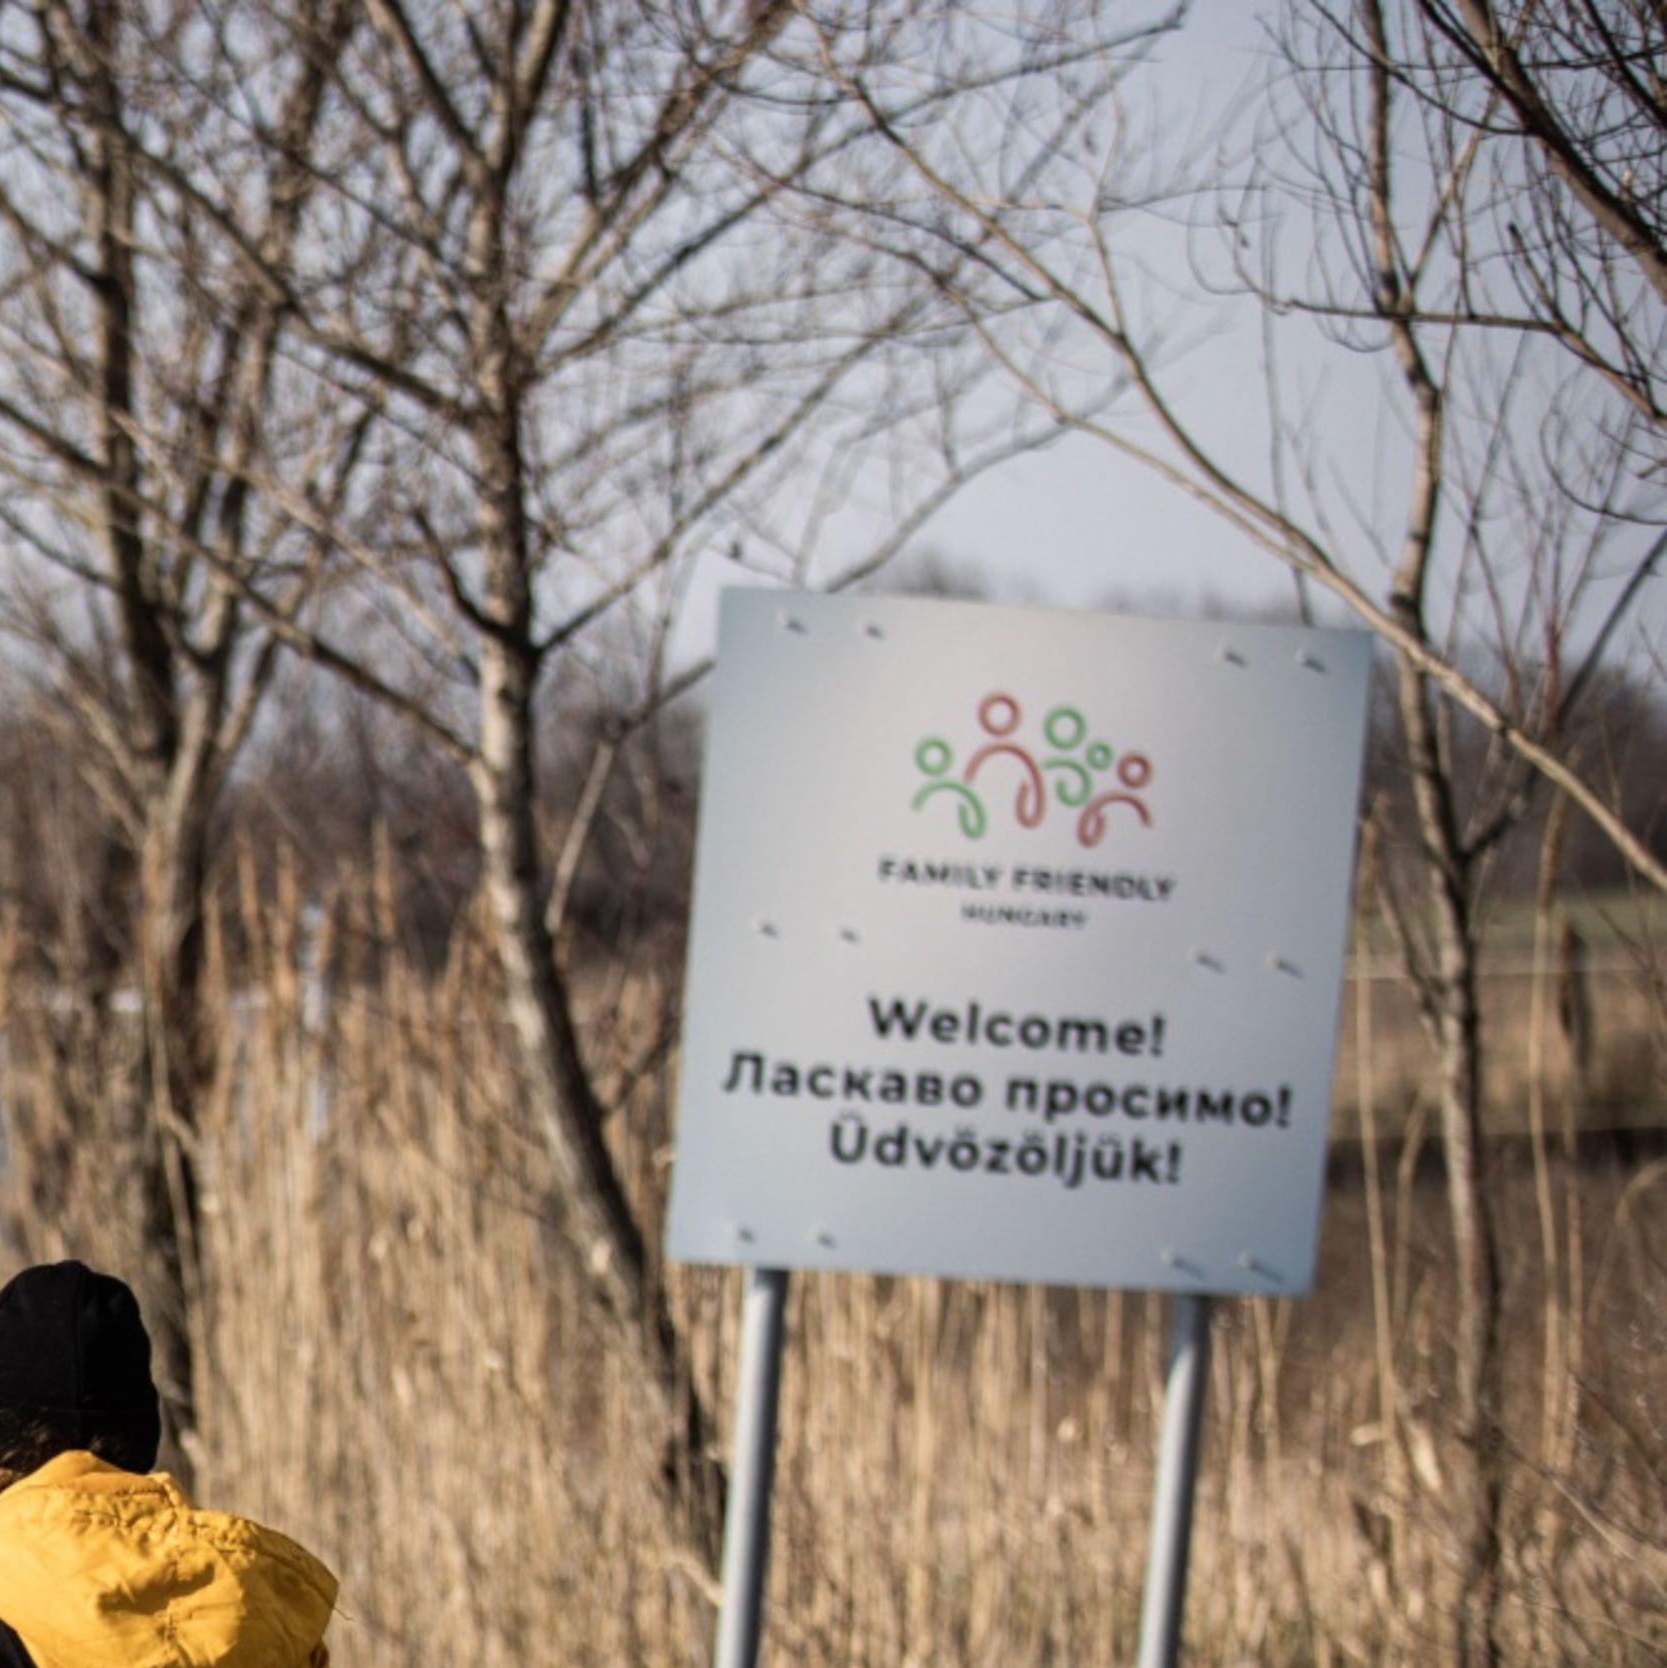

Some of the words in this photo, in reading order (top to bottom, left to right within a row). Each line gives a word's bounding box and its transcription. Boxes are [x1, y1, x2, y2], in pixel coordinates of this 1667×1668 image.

[878, 858, 1001, 889] FAMILY
[1013, 868, 1178, 902] FRIENDLY
[962, 902, 1088, 930] HUNGARY
[868, 997, 1167, 1059] Welcome!
[723, 1050, 984, 1110] Ласкаво
[1006, 1078, 1294, 1131] просимо!
[831, 1110, 1182, 1190] Üdvözöljük!
